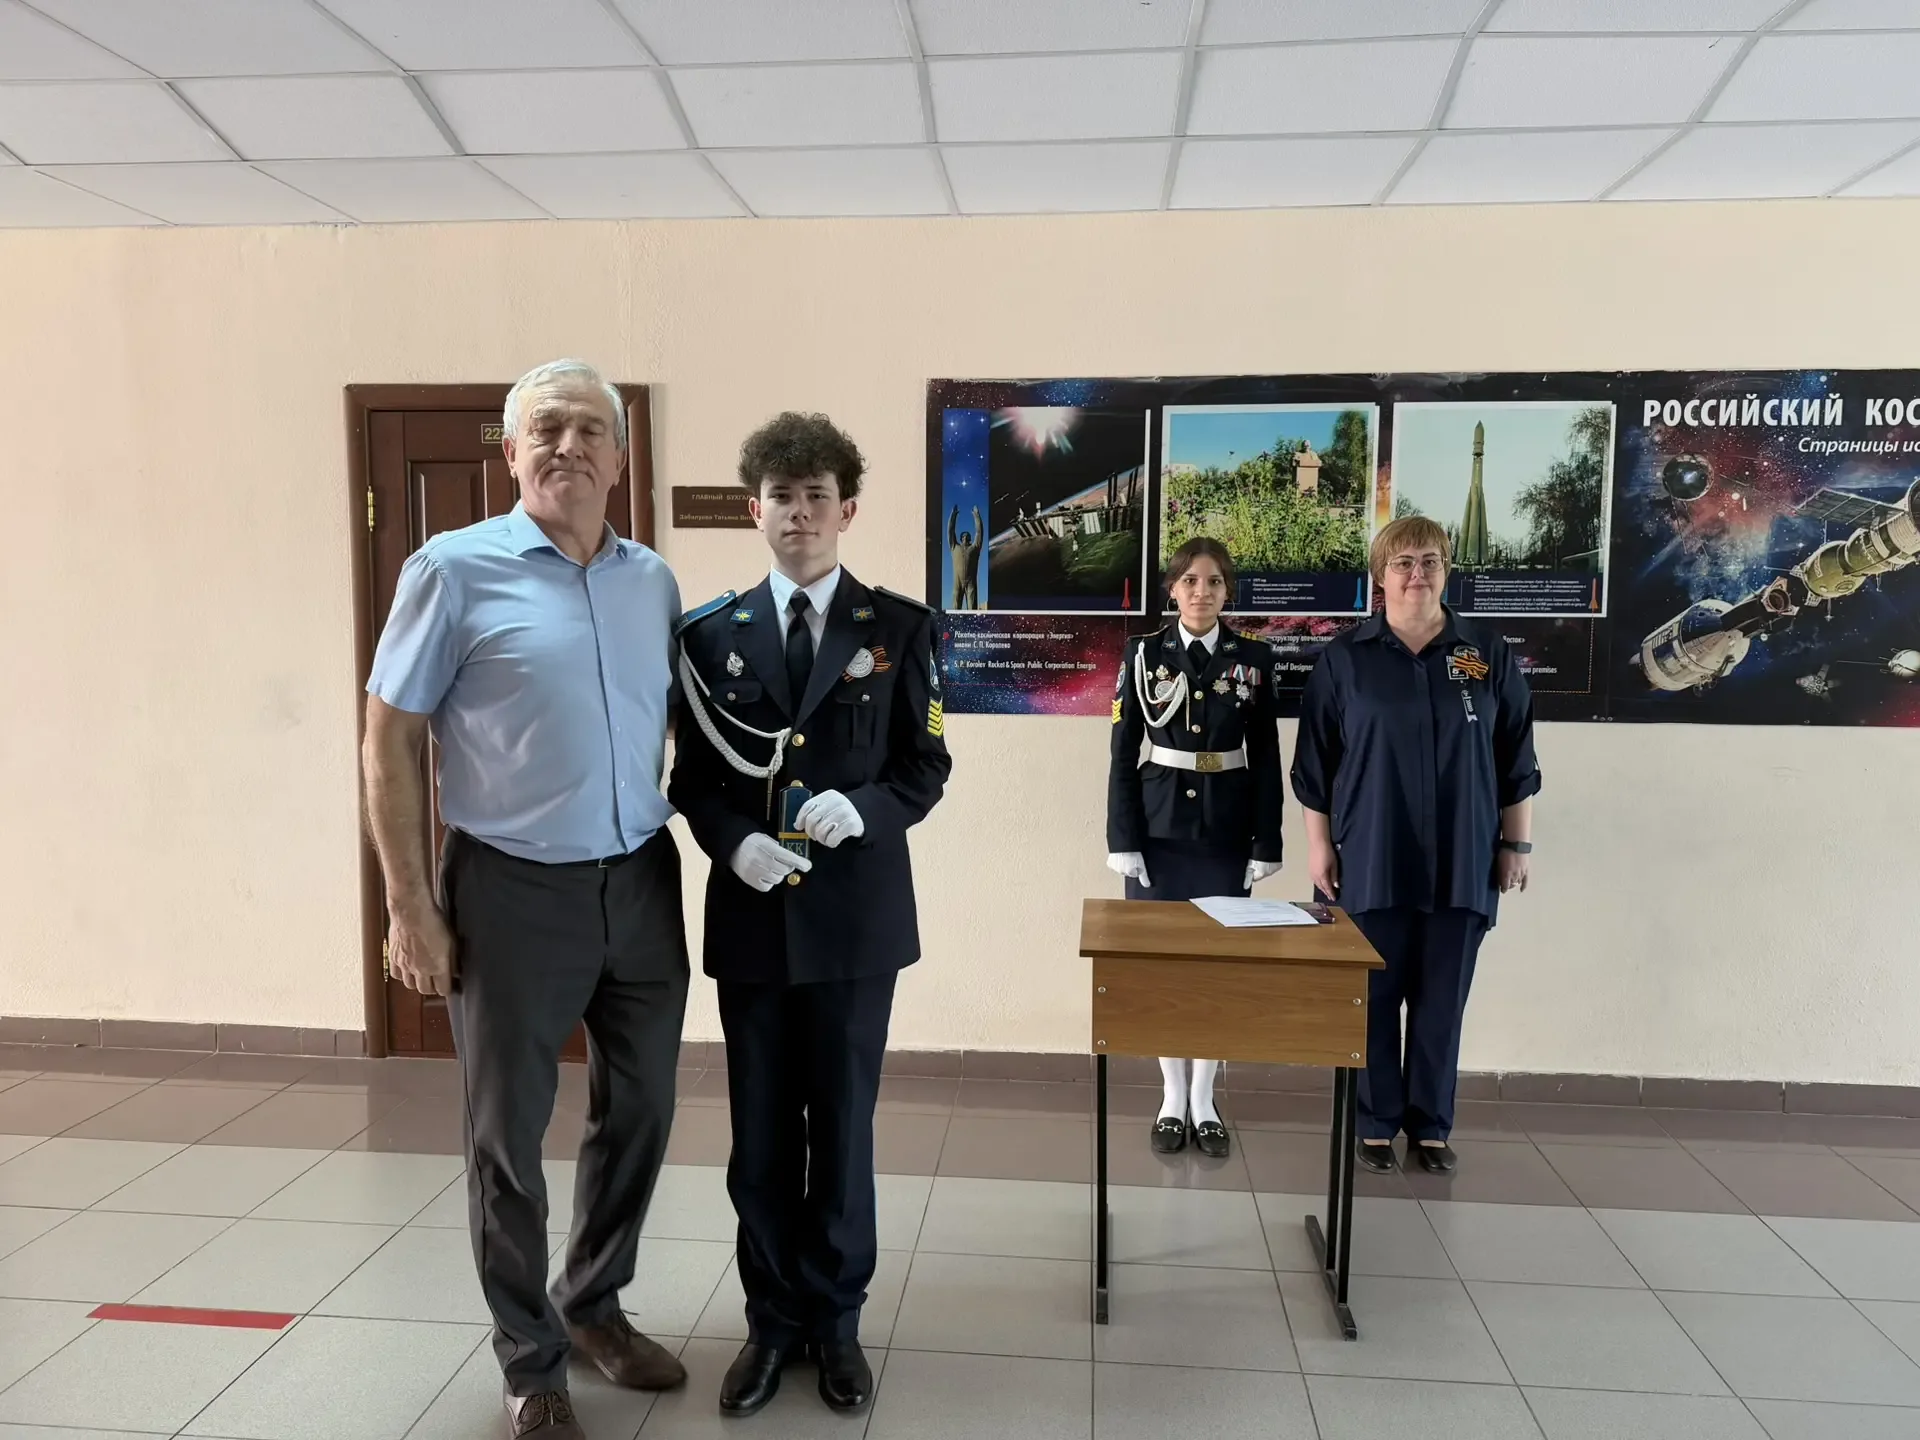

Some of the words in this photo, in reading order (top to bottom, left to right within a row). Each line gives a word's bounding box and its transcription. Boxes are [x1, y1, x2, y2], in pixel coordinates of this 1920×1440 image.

[1643, 393, 1844, 427] РОССИЙСКИЙ
[1797, 436, 1899, 456] Страницы
[1012, 632, 1045, 640] корпорация
[985, 642, 1011, 650] Королева
[966, 660, 987, 668] Korolev
[1027, 661, 1043, 669] Public
[1044, 661, 1075, 670] Corporation
[1076, 661, 1097, 671] Energia
[1274, 662, 1289, 671] Chief
[1289, 662, 1314, 673] Designer
[1532, 665, 1558, 675] premises
